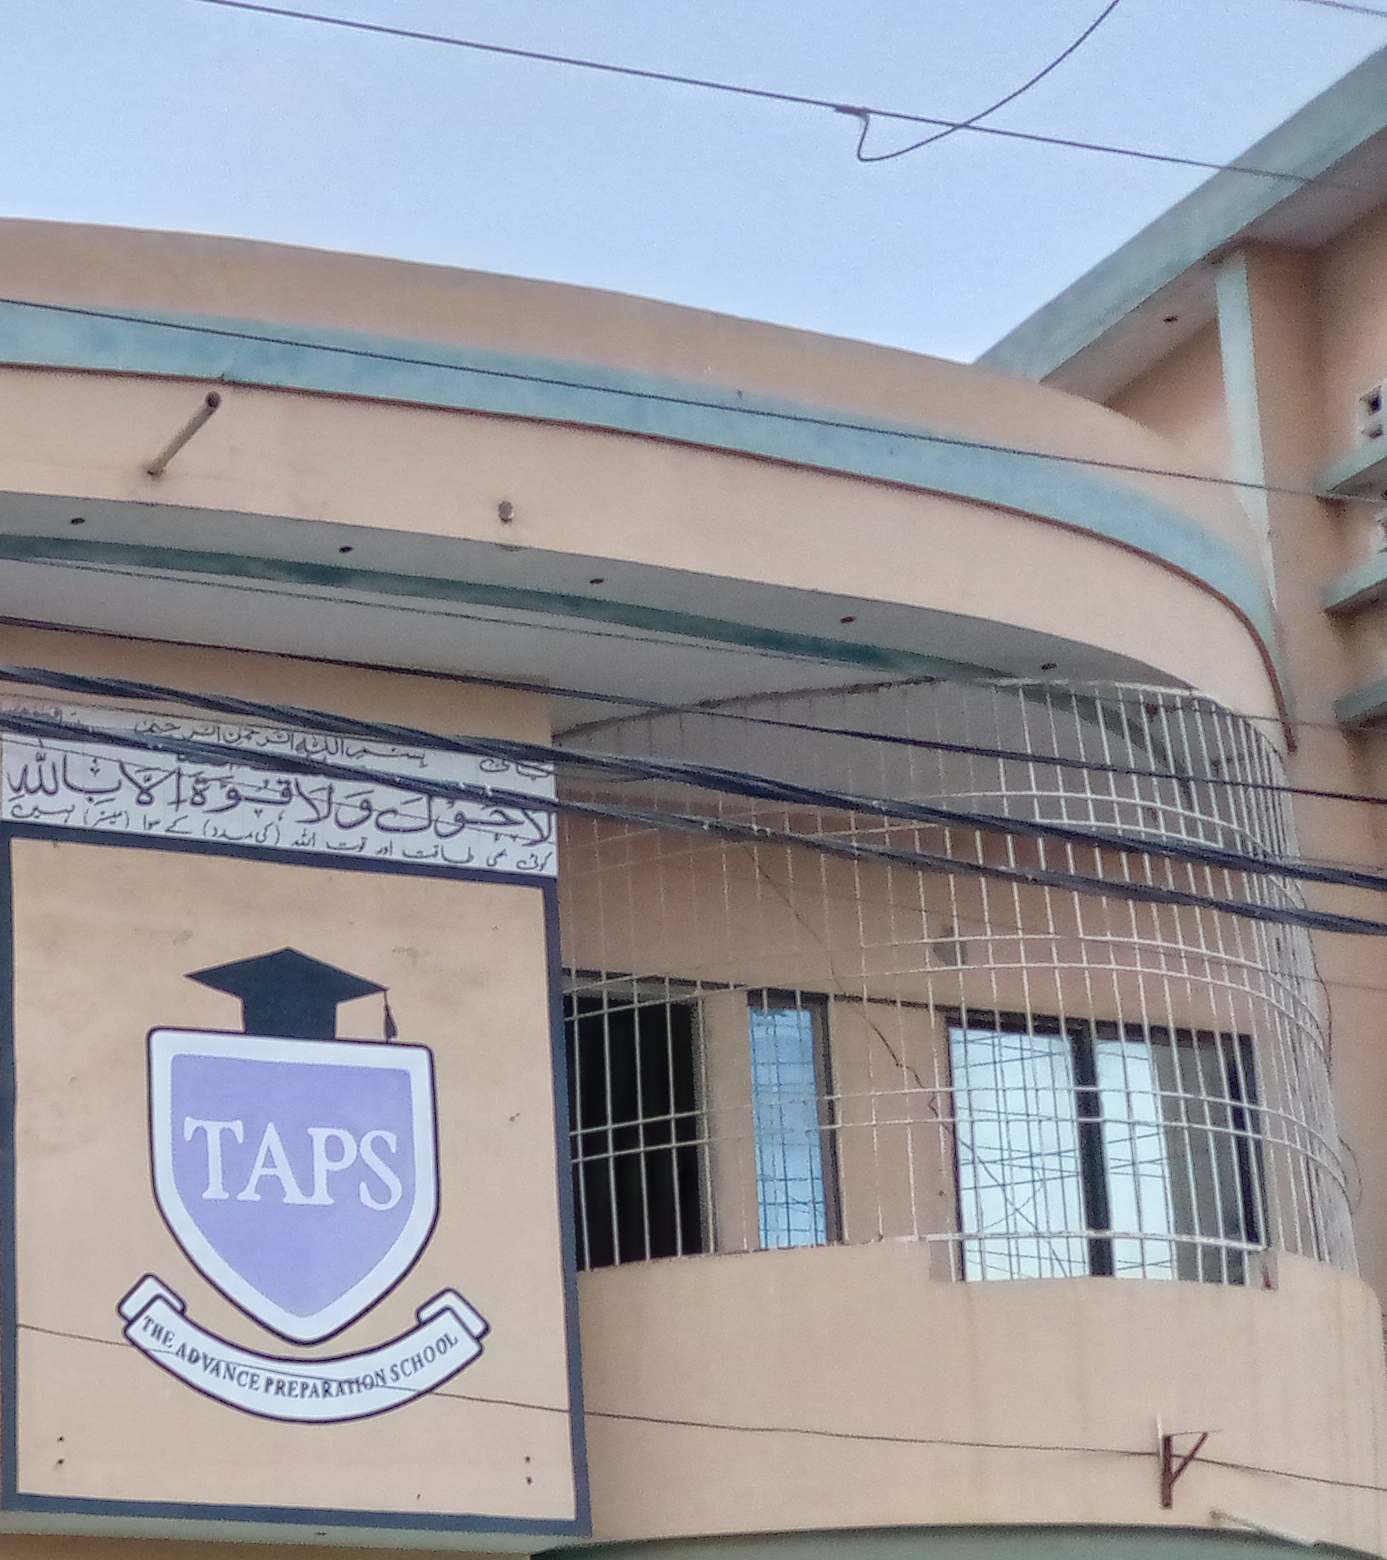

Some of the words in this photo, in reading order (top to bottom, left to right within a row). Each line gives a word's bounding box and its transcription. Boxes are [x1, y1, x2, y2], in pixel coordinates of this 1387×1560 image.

[182, 1115, 405, 1212] TAPS
[140, 1314, 175, 1349] THE
[176, 1341, 261, 1391] ADVANCE
[263, 1367, 388, 1401] PREPARATION
[390, 1330, 461, 1383] SCHOOL
